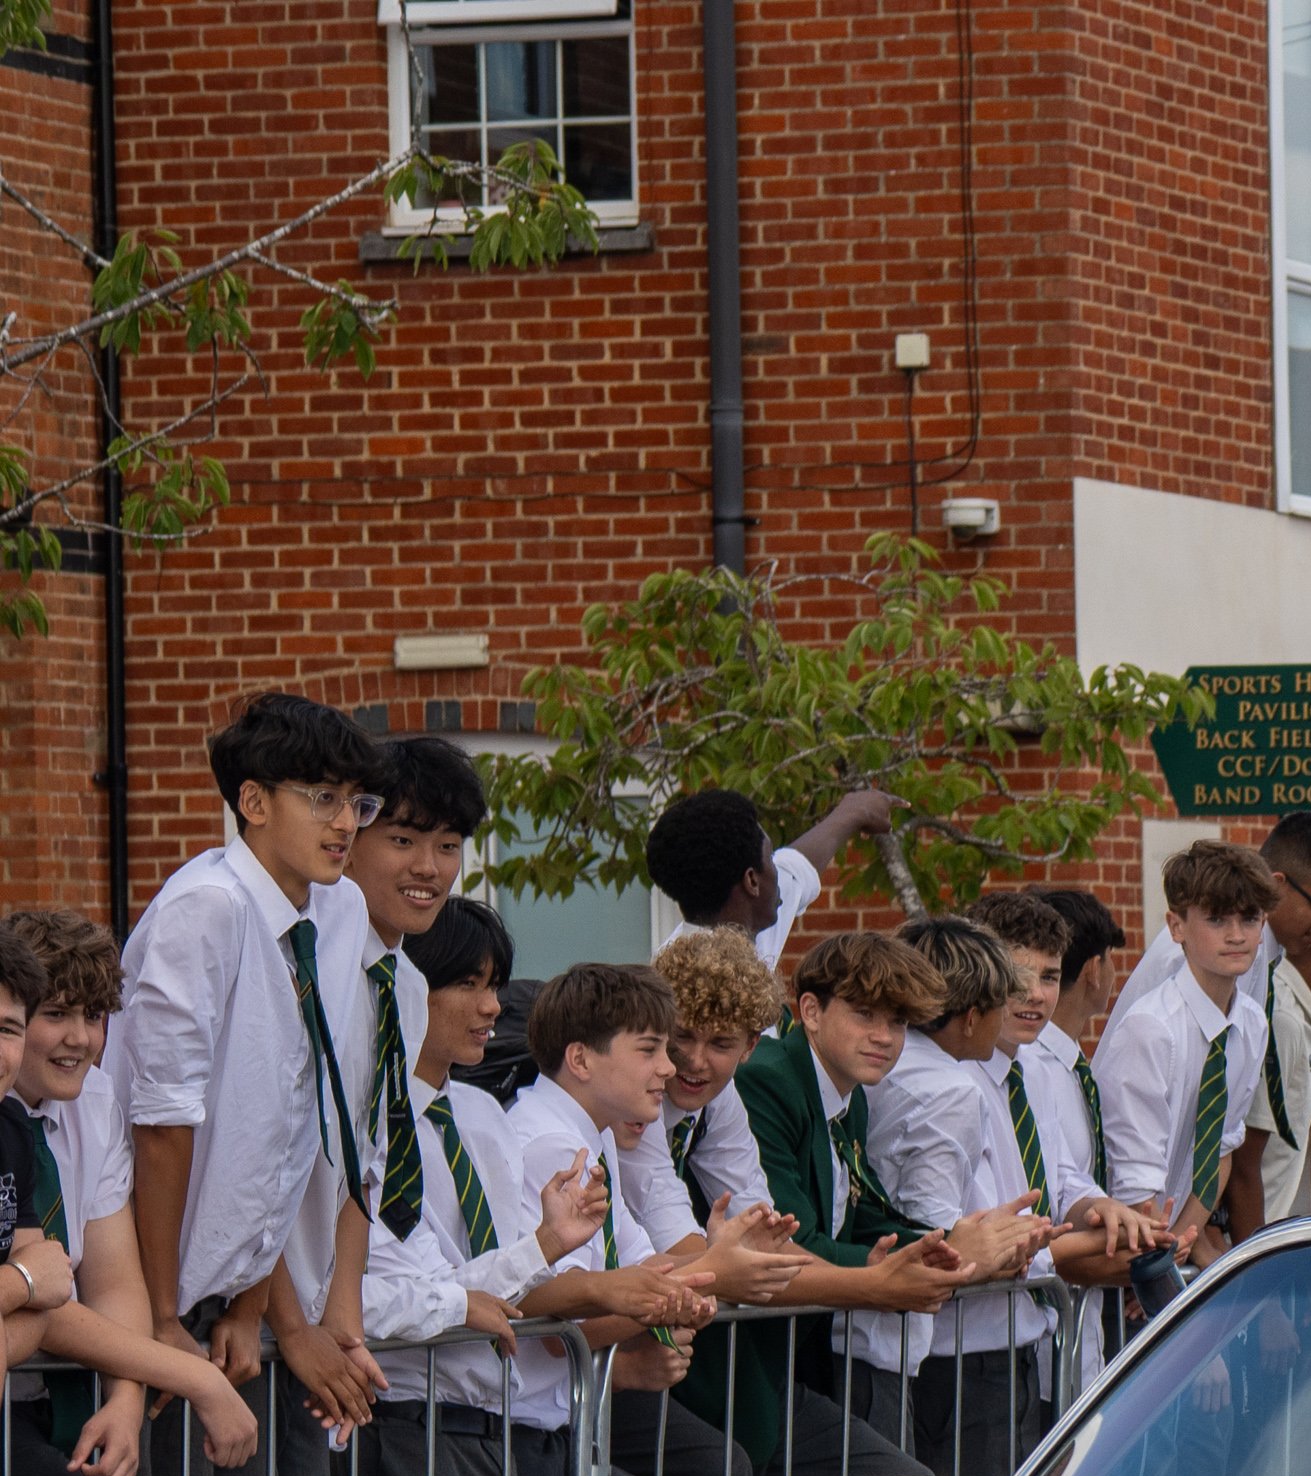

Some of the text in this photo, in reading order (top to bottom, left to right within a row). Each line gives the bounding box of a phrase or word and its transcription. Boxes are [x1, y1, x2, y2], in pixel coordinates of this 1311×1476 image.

[1199, 672, 1282, 695] SPORTS
[1196, 728, 1256, 749] BACK
[1195, 784, 1261, 805] BAND
